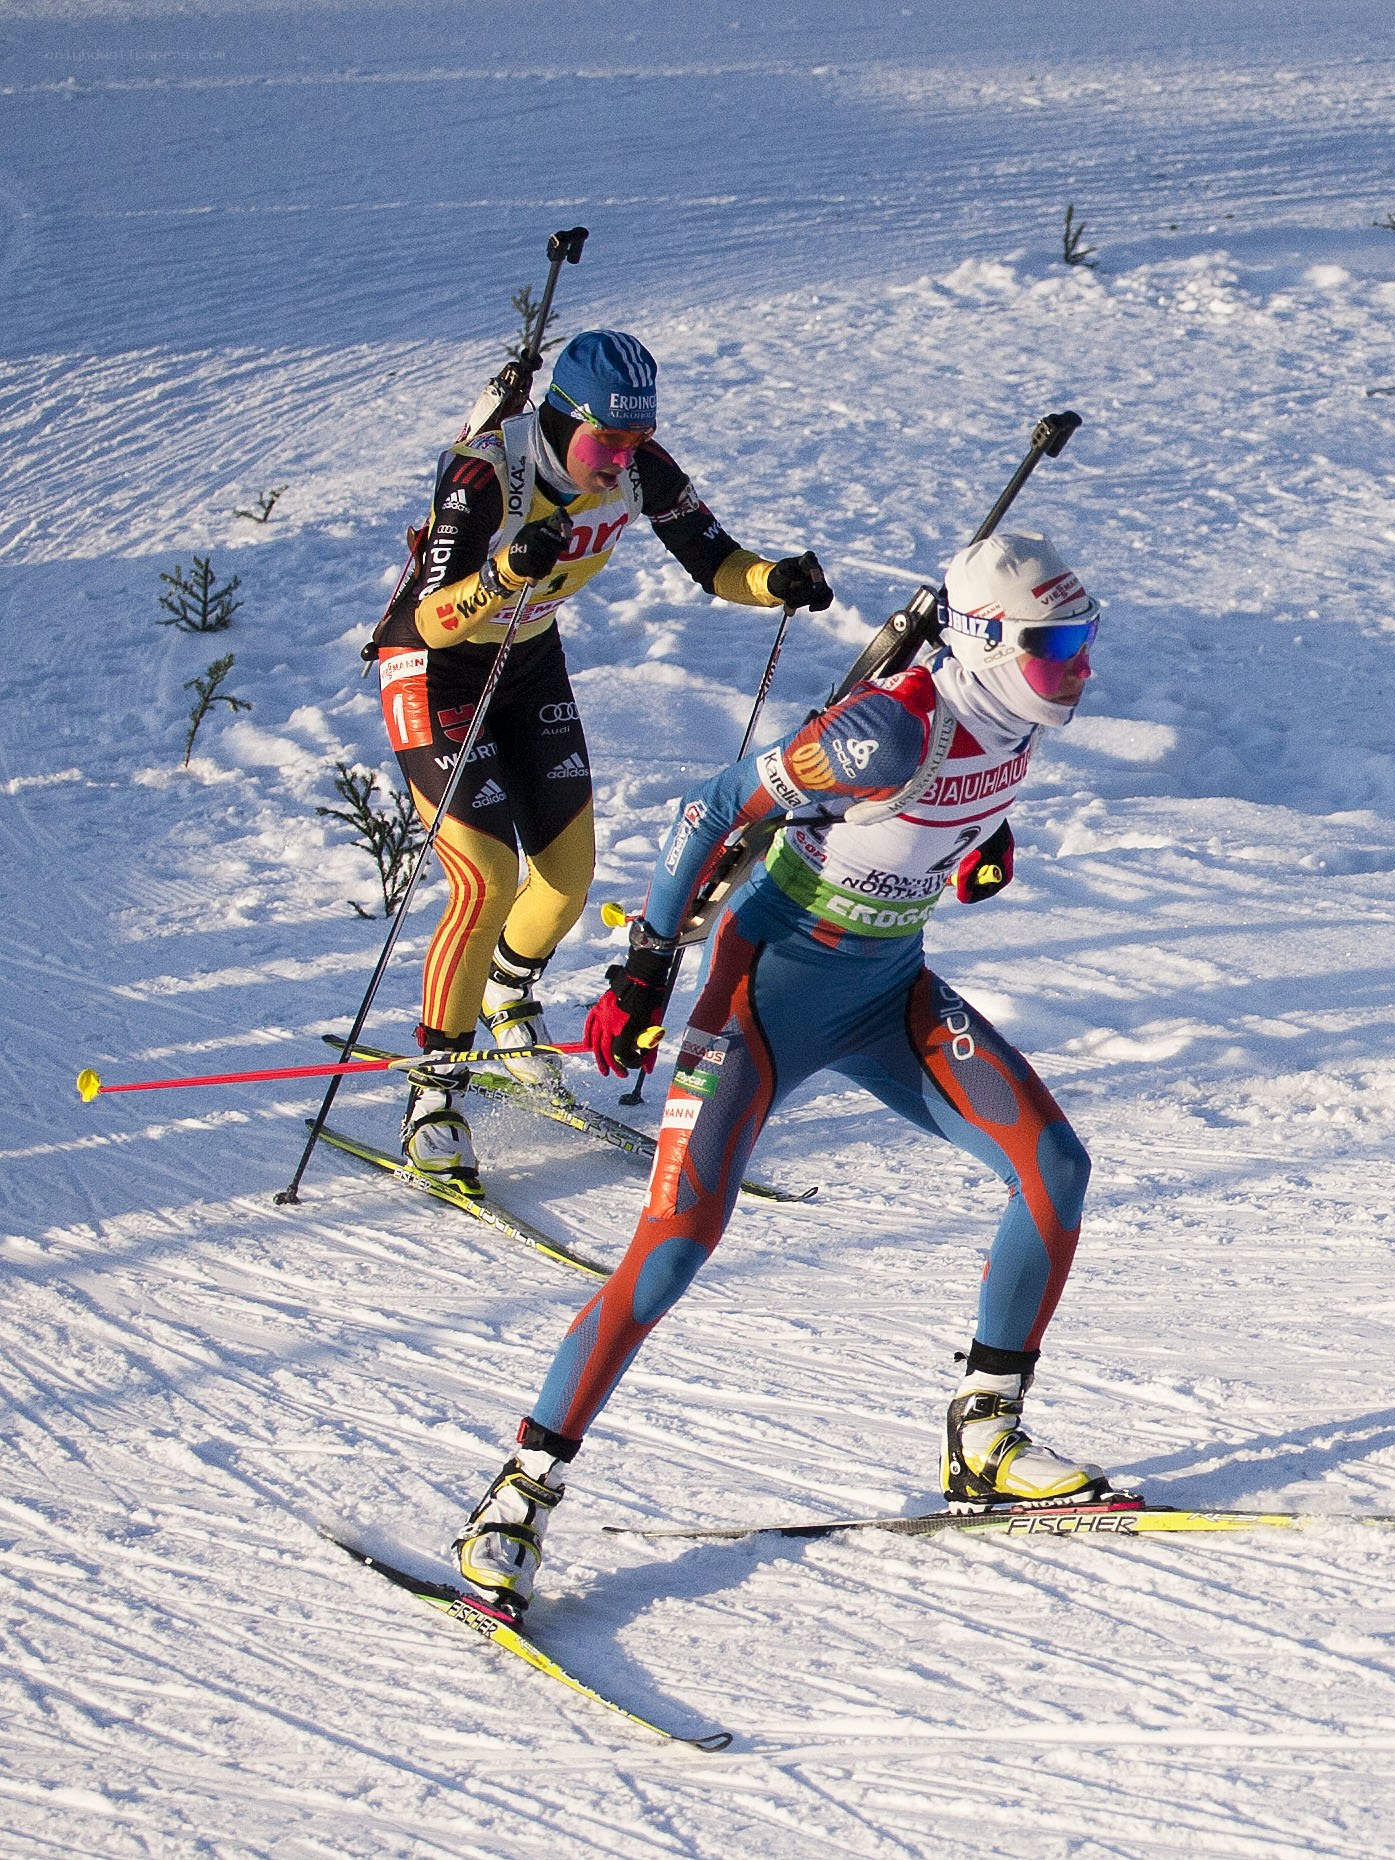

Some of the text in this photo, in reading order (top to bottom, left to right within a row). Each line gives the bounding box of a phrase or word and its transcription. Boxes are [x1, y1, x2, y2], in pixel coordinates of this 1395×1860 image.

[983, 646, 1016, 664] odlo
[392, 693, 409, 744] 1
[540, 725, 570, 736] Audi
[546, 768, 589, 780] adidas
[831, 738, 857, 780] odlo
[763, 751, 802, 809] Karelia
[1007, 1515, 1139, 1536] FISCHER
[446, 1599, 499, 1639] FISCHER
